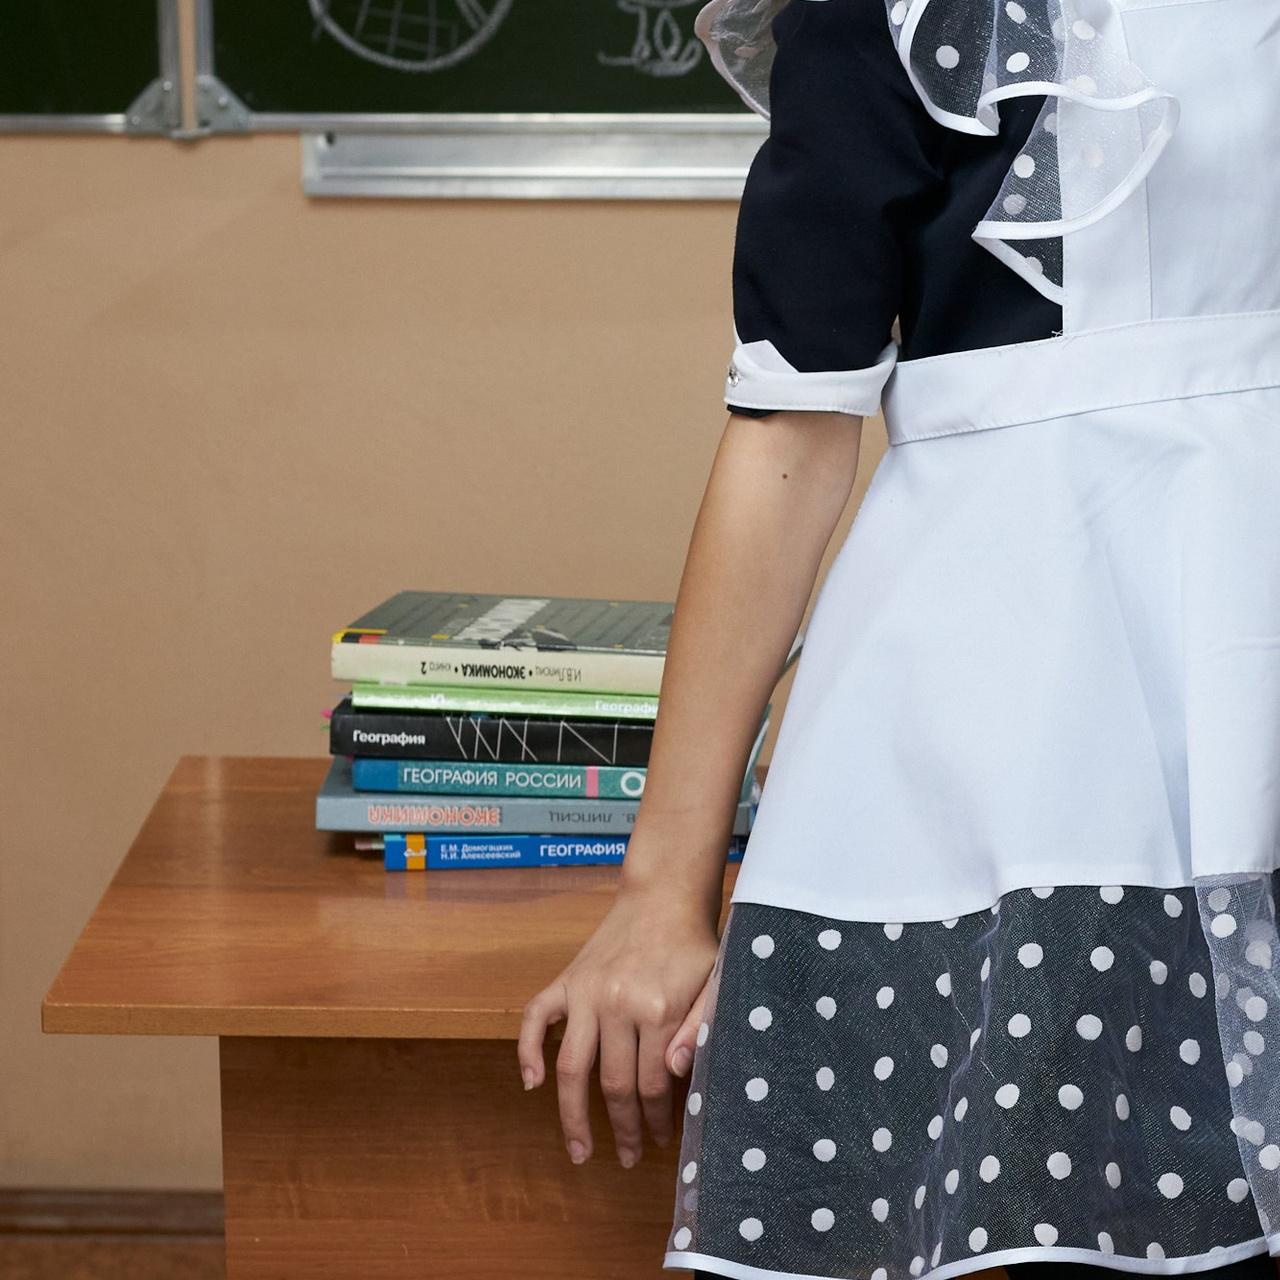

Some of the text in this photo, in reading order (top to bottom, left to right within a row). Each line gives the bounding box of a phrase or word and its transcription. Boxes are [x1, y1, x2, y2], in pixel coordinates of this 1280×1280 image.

[461, 663, 526, 680] ЭКОНОМИКА
[352, 729, 426, 748] География
[402, 766, 582, 790] ГЕОГРАФИЯ РОССИИ
[368, 804, 501, 827] ЭКОНОМИКА
[549, 810, 613, 824] ЛИПСИЦ
[540, 843, 626, 858] ГЕОГРАФИЯ
